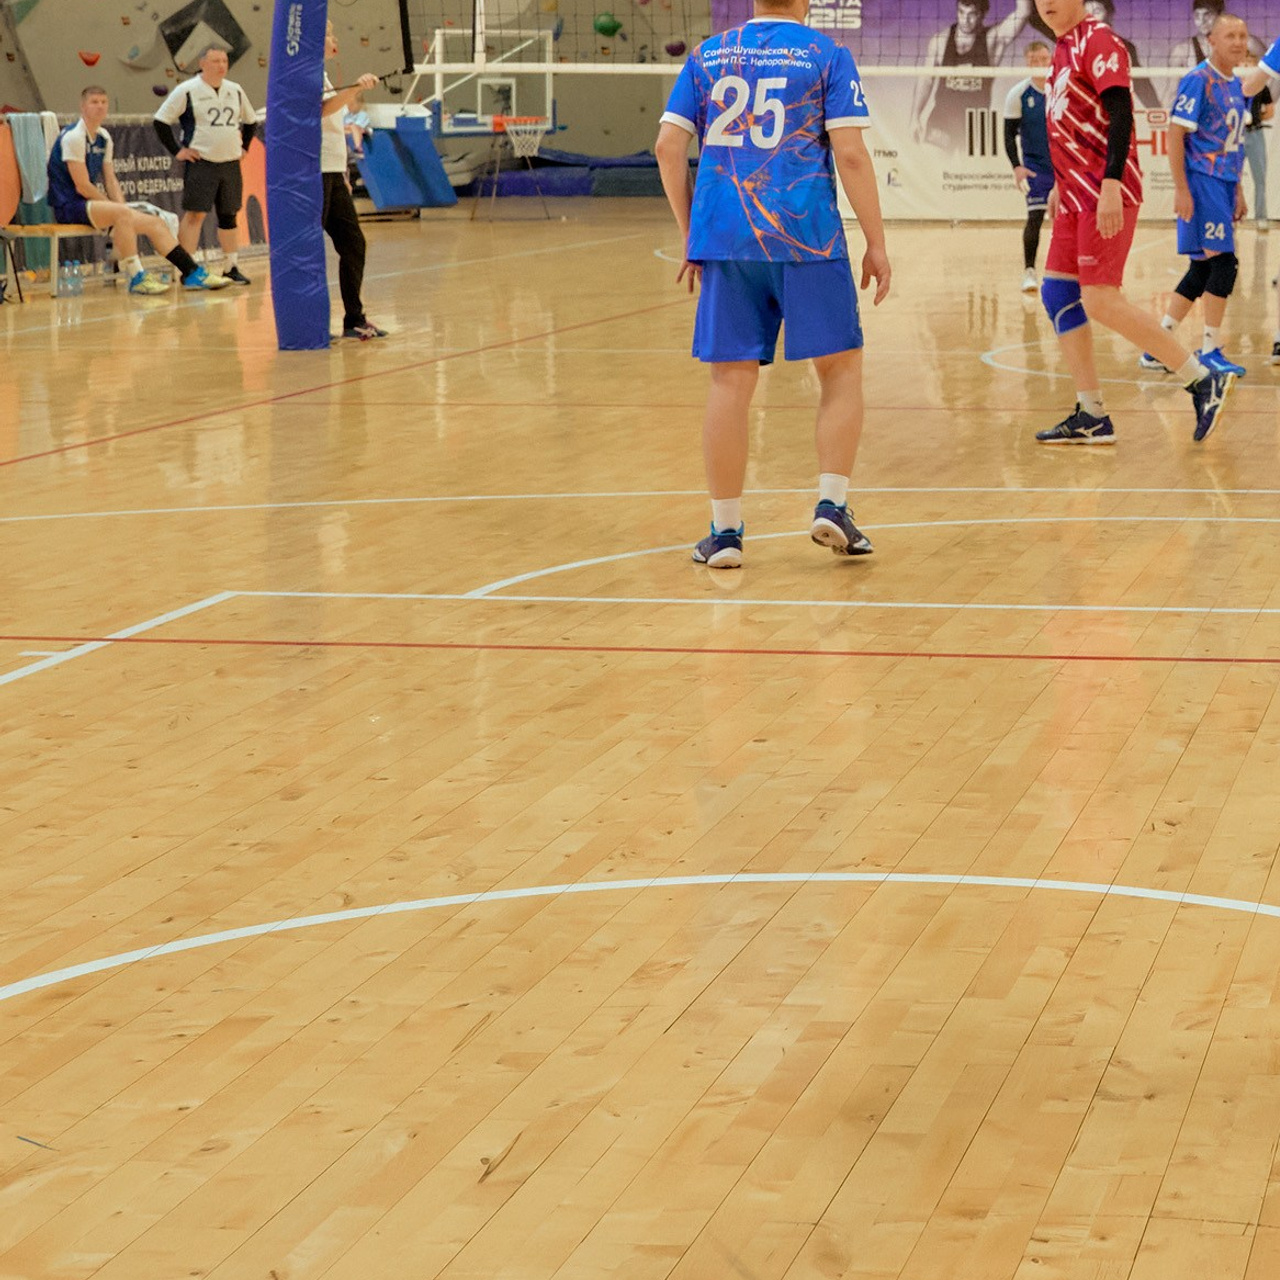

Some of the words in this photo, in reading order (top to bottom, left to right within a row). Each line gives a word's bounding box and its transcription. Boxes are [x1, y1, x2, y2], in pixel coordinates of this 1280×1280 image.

[804, 8, 862, 29] 25
[788, 47, 810, 59] ГЭС
[1092, 52, 1119, 78] 64
[706, 75, 788, 150] 25
[1175, 94, 1197, 114] 24
[207, 106, 236, 127] 22
[136, 155, 172, 171] КЛАСТЕР
[136, 177, 185, 195] ФЕДЕРАЛЬН
[1204, 222, 1226, 240] 24
